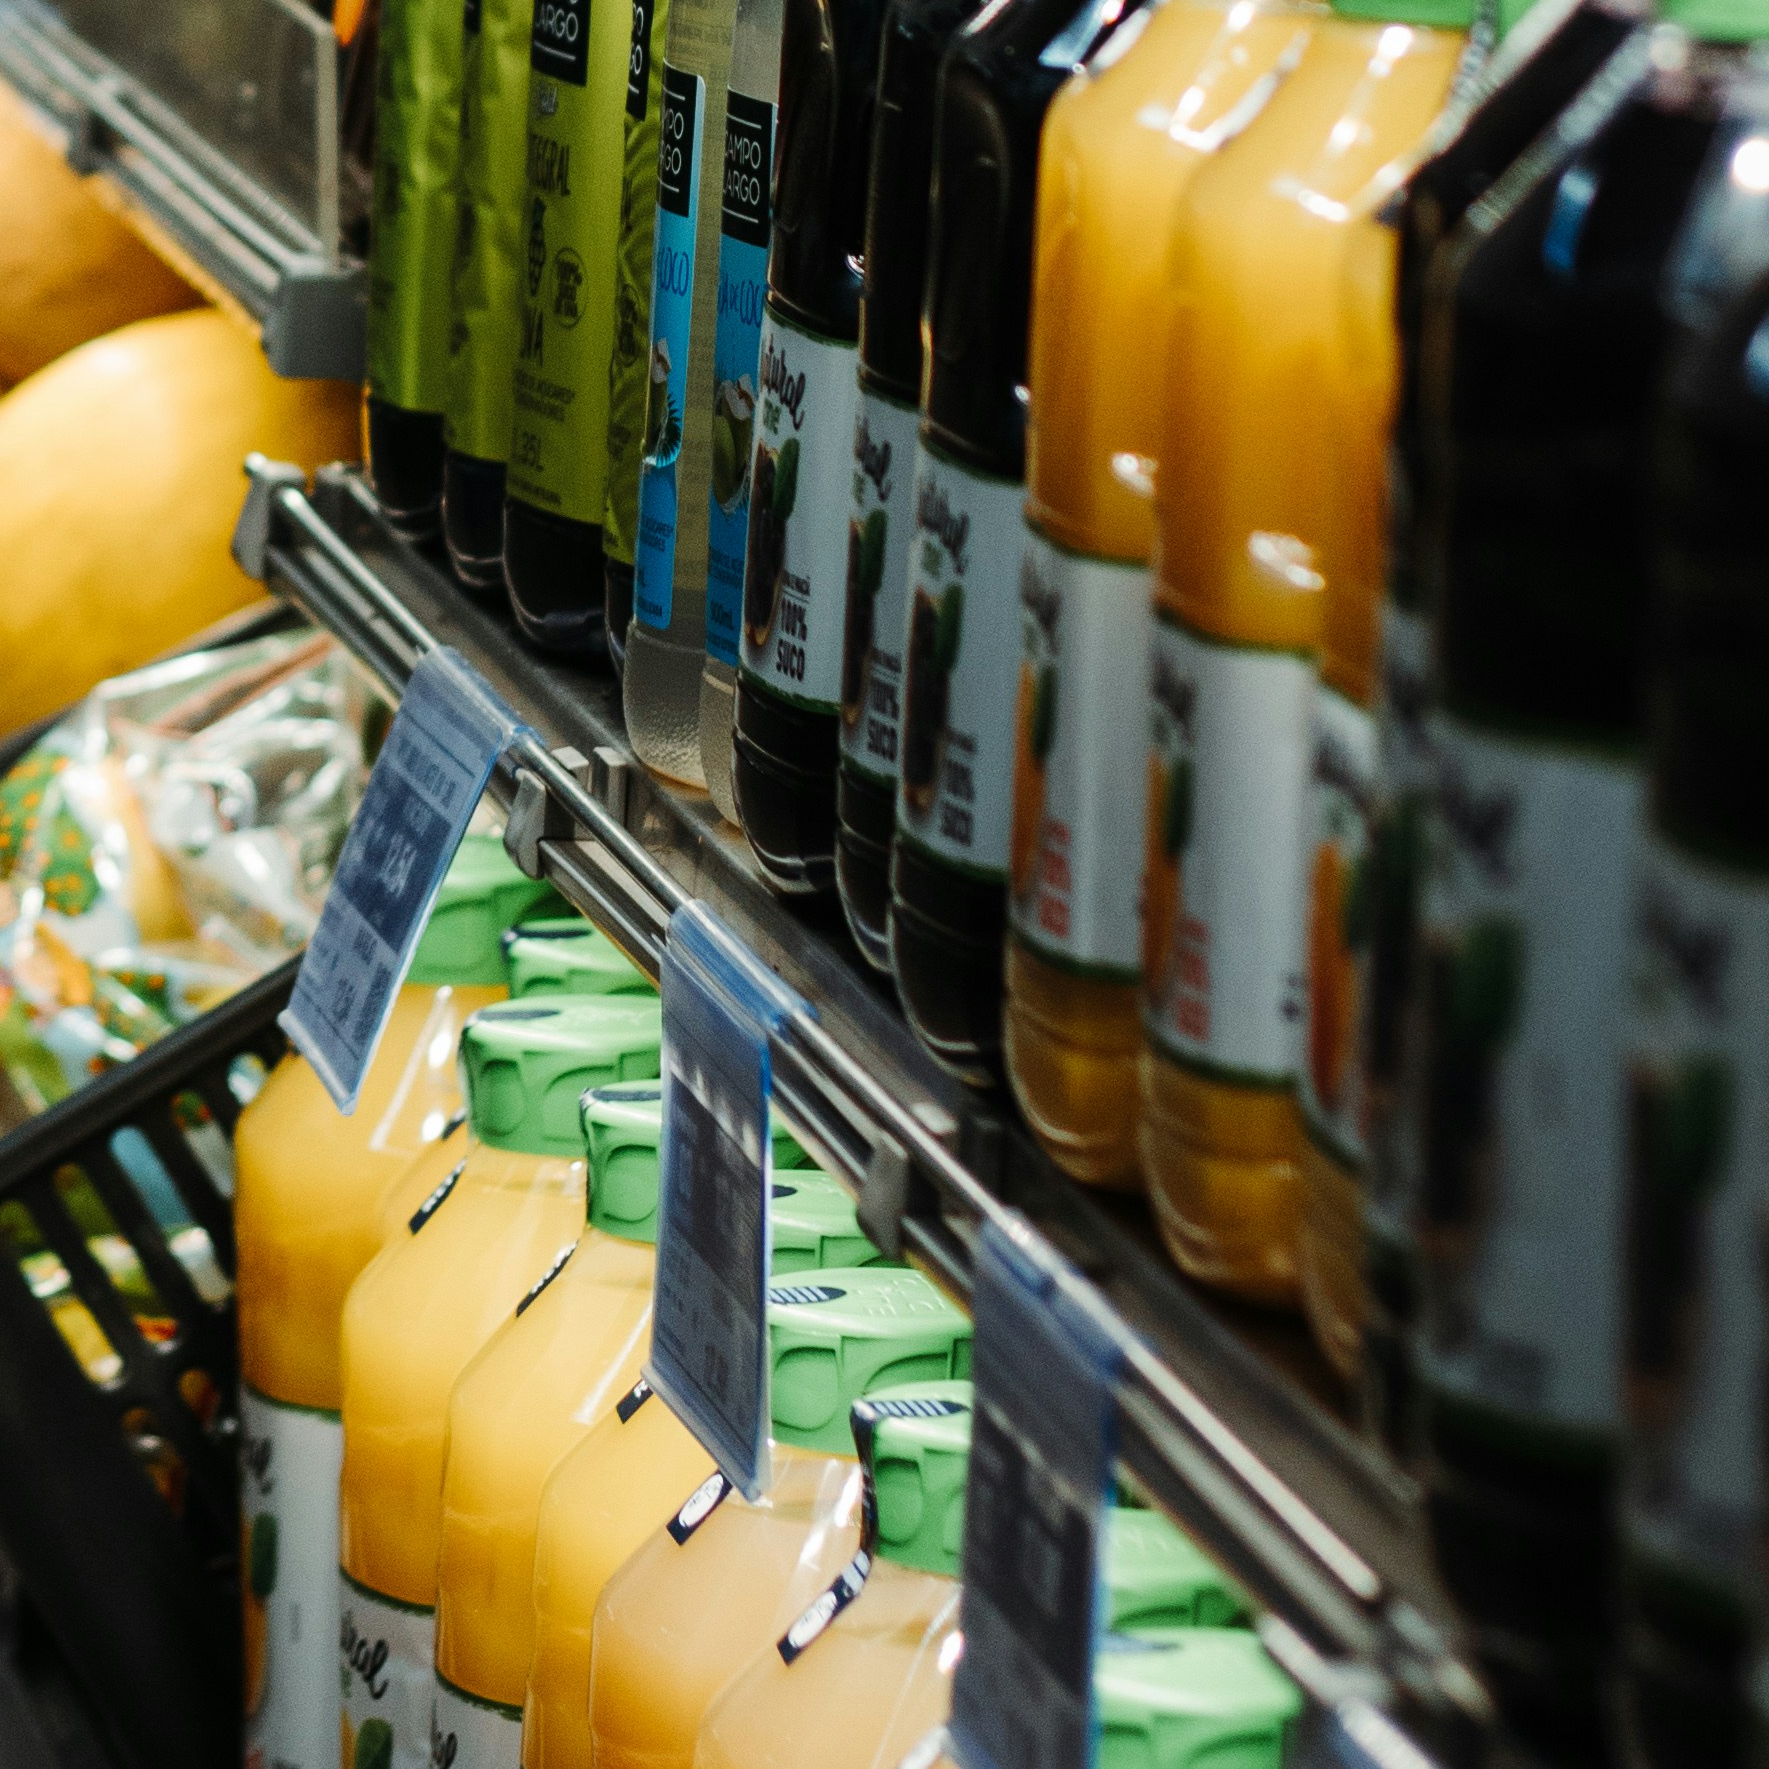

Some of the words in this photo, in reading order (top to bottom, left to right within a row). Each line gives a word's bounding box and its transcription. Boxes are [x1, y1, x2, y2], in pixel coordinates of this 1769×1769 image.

[534, 3, 579, 42] ARGO
[781, 597, 808, 641] 100%
[775, 638, 805, 682] SUCO
